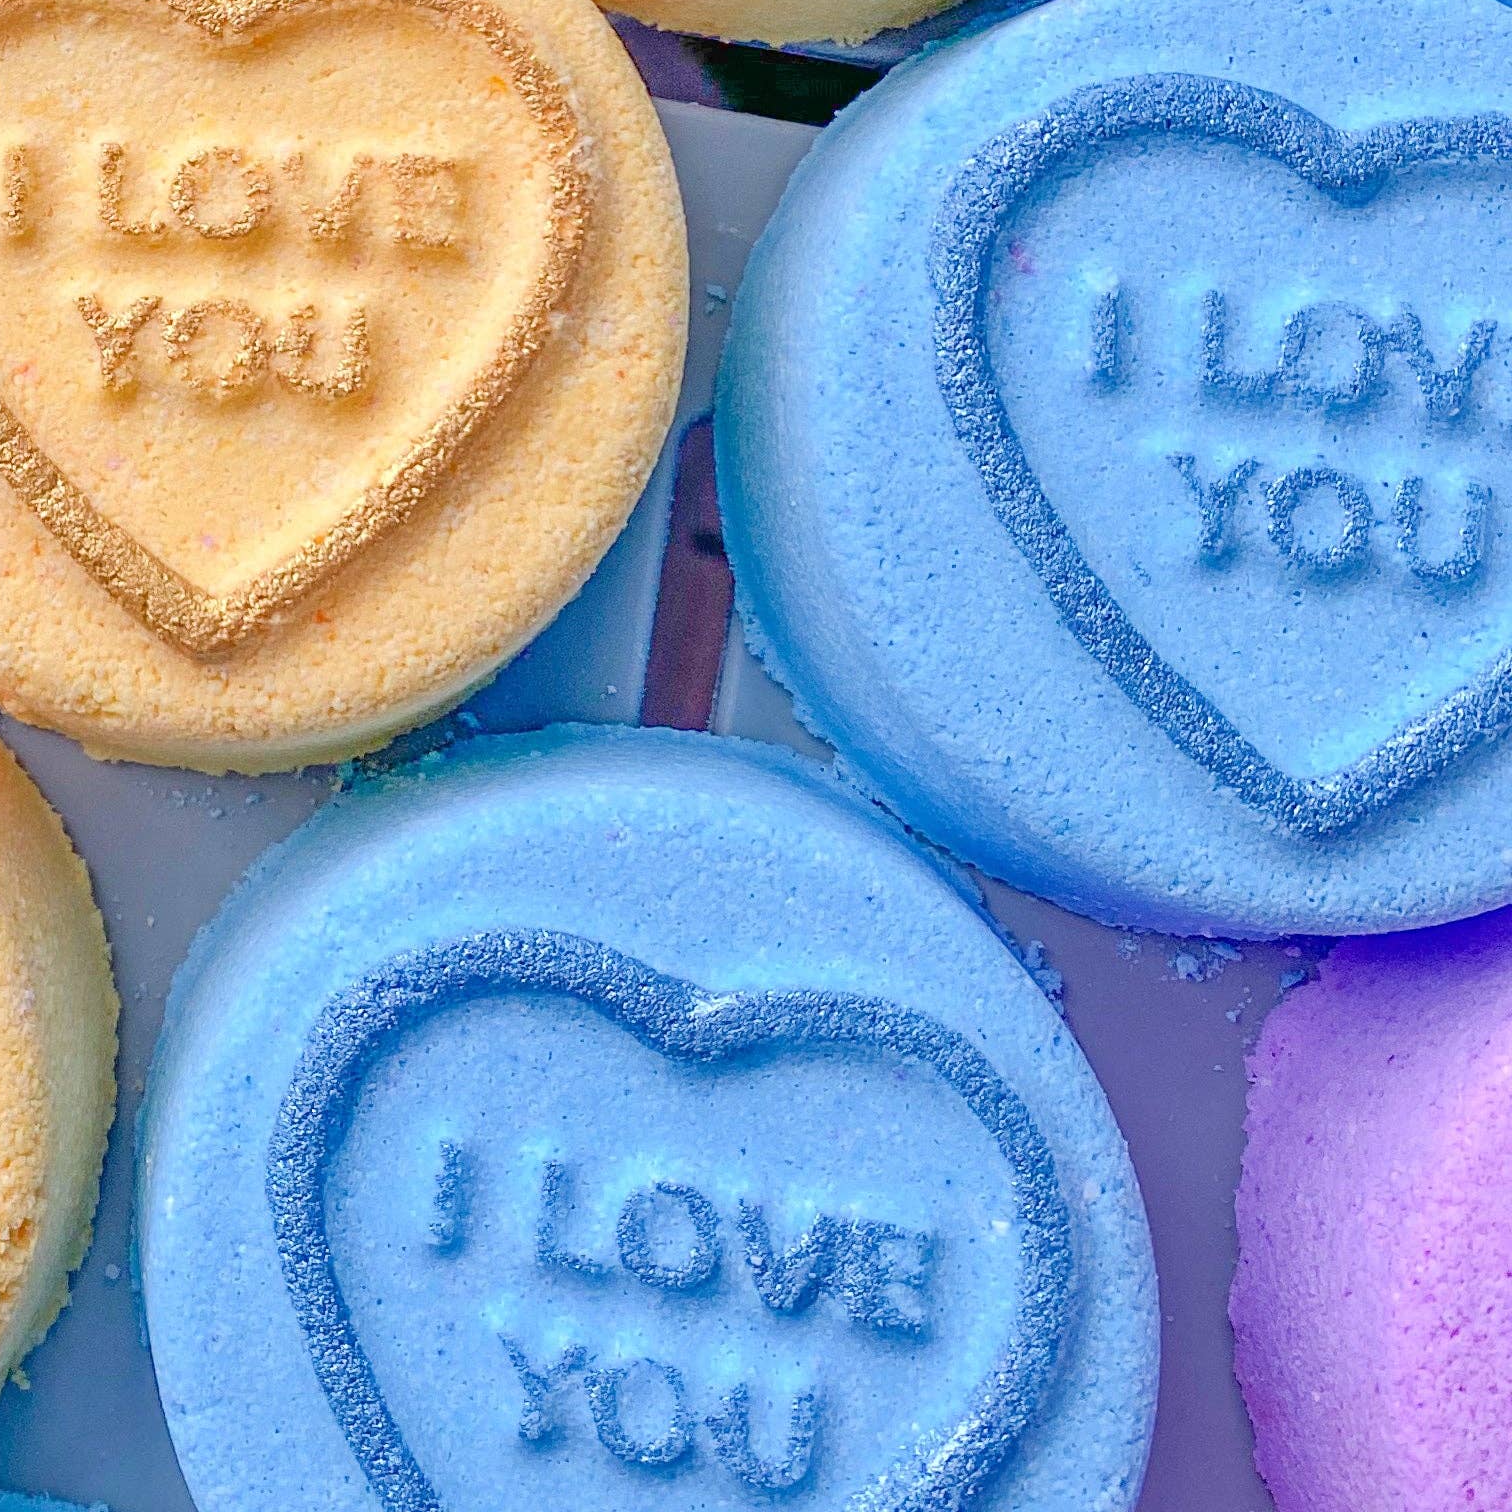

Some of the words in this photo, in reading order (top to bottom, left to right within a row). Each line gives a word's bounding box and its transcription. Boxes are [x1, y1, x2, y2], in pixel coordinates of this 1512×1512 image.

[1, 143, 28, 234] I
[98, 141, 456, 250] LOVE
[73, 293, 370, 400] YOU
[1091, 287, 1120, 378] I
[1166, 451, 1491, 583] YOU
[428, 1138, 466, 1246] I
[534, 1160, 930, 1336] LOVE
[496, 1332, 820, 1490] YOU
